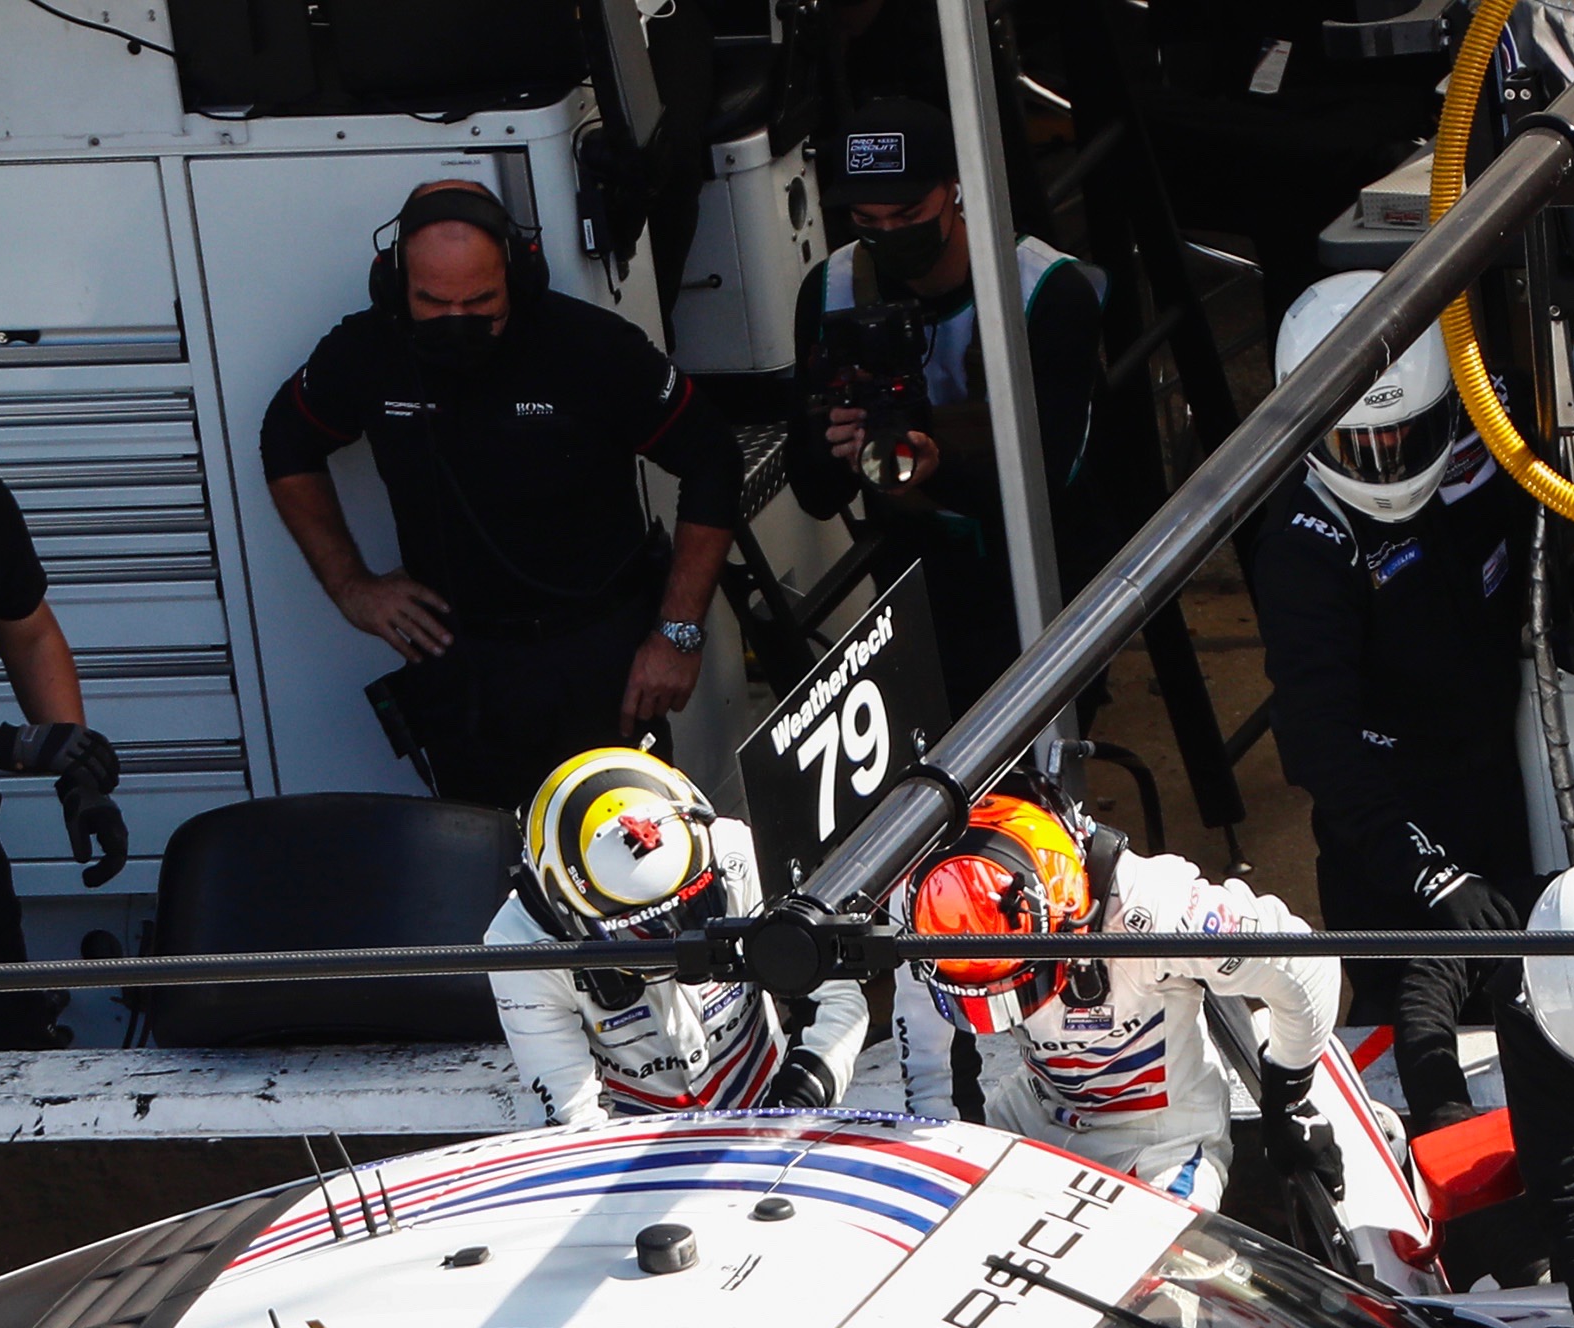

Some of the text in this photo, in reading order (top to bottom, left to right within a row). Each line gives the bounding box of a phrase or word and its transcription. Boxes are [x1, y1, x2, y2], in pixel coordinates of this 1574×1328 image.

[516, 402, 554, 412] BOSS
[1291, 512, 1347, 546] HRX
[1362, 729, 1398, 748] RX
[796, 678, 891, 843] 79
[600, 868, 714, 933] WeatherTech
